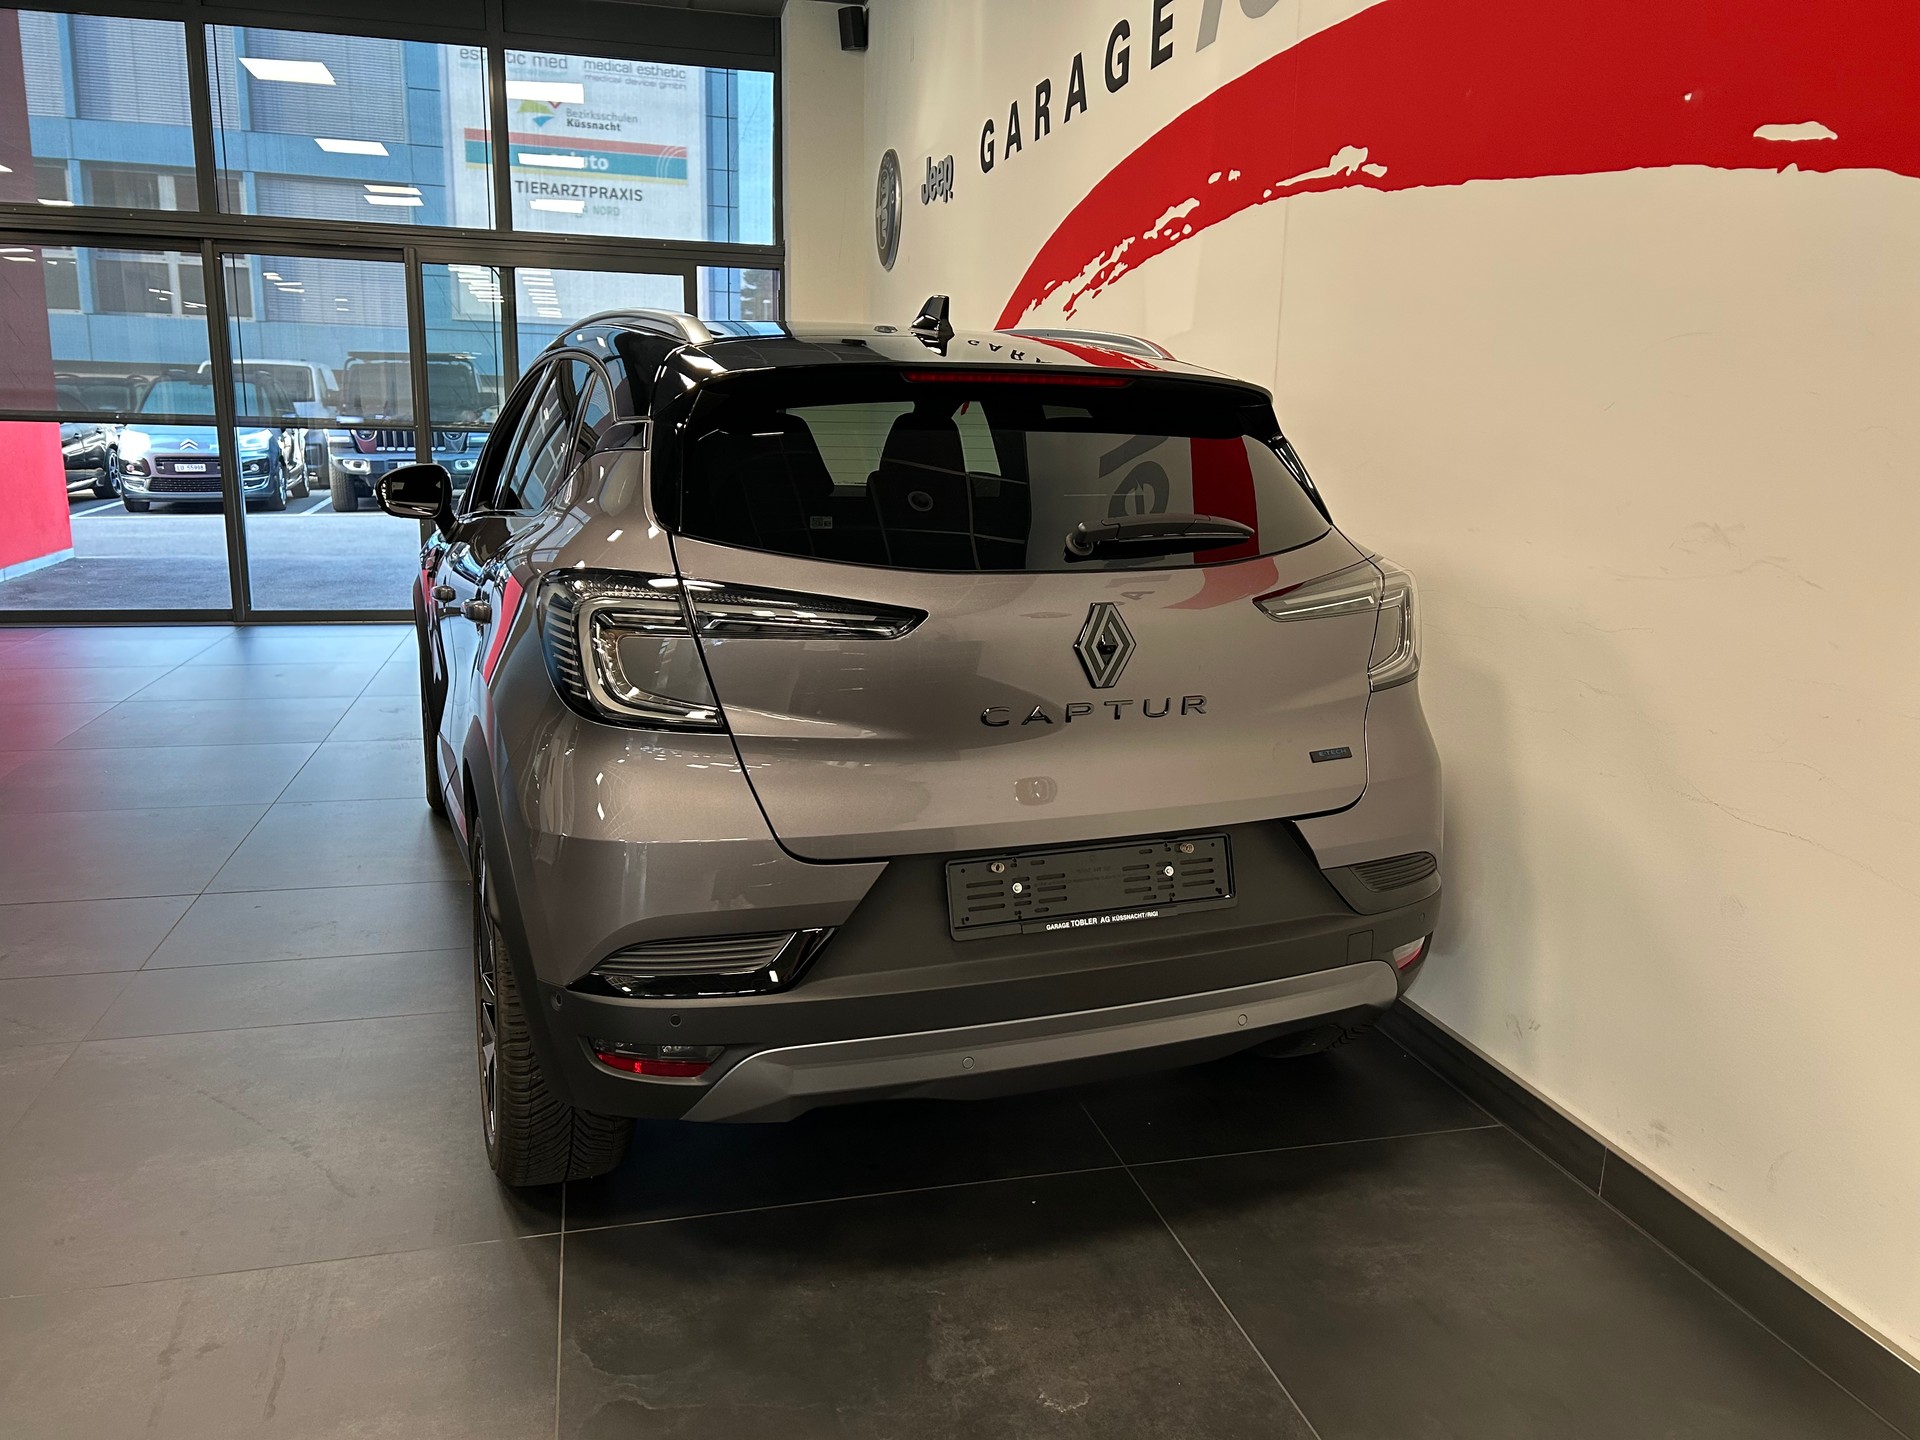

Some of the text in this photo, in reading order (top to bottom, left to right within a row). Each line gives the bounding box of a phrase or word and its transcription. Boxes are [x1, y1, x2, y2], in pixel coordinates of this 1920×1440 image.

[532, 55, 568, 69] med
[583, 60, 633, 74] medical
[636, 65, 687, 79] esthetic
[980, 0, 1174, 174] GARAGE
[566, 107, 638, 123] Bezirksschulen
[566, 118, 621, 132] Küssnacht
[920, 154, 954, 206] Jeep
[514, 180, 643, 202] TIERARZTPRAXIS
[593, 205, 620, 216] NORD
[980, 694, 1208, 728] CAPTUR
[1046, 921, 1070, 931] GARAGE
[1070, 917, 1098, 927] TOBLER
[1100, 915, 1111, 924] AG
